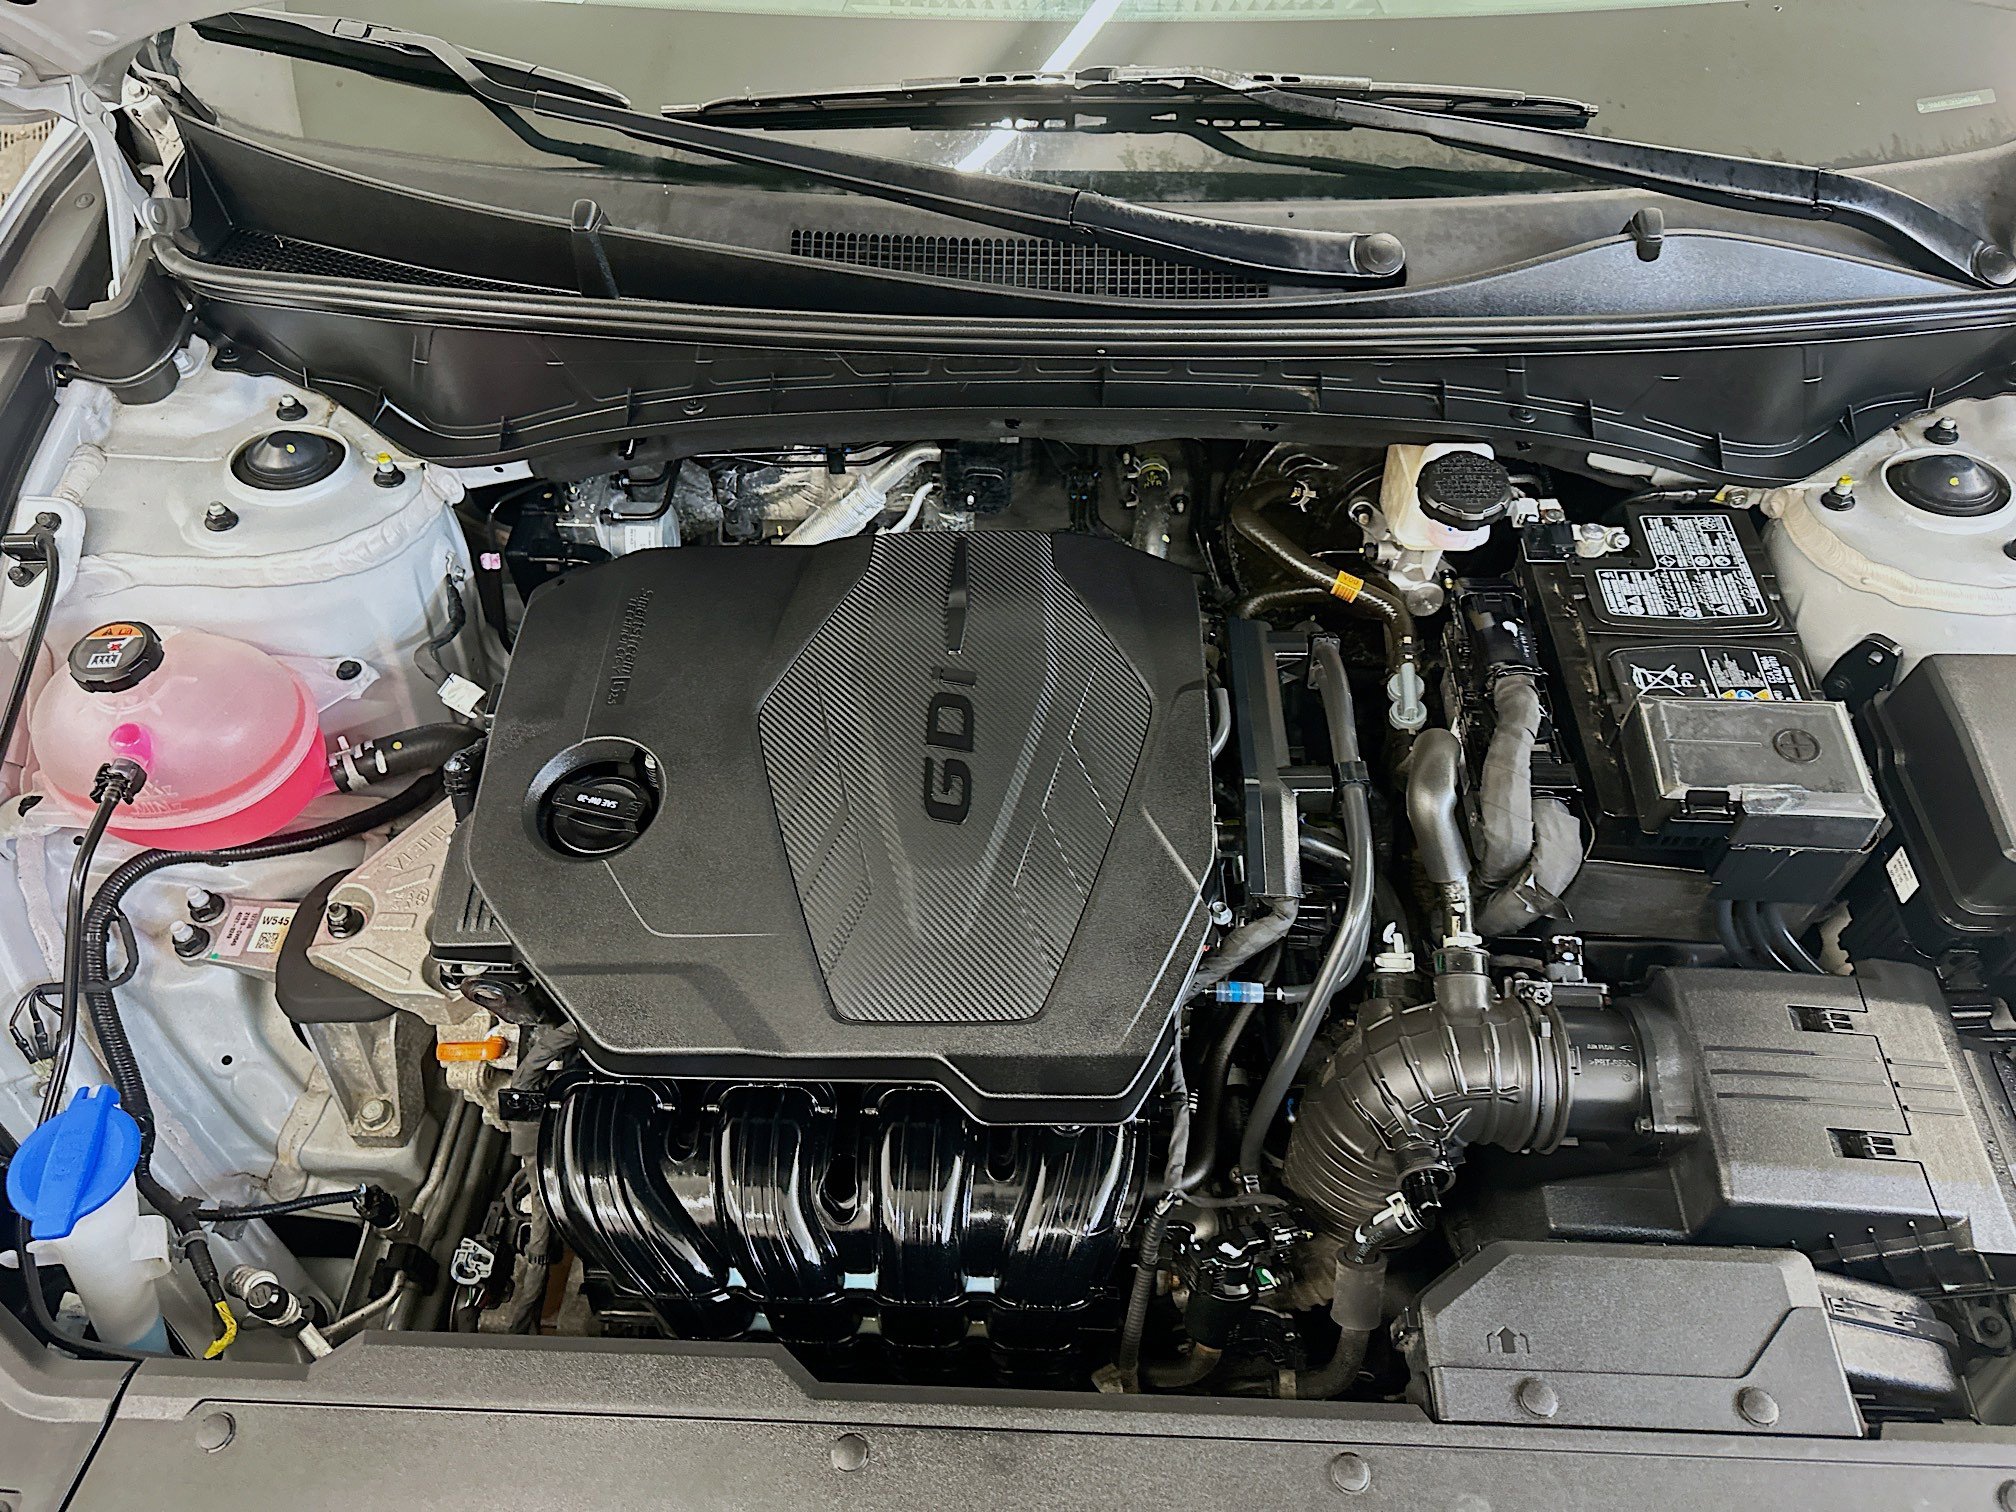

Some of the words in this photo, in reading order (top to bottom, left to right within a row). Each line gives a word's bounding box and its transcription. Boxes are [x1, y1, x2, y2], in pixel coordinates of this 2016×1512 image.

[1679, 672, 1697, 689] Pb
[600, 798, 619, 809] SAE
[262, 916, 291, 926] W545
